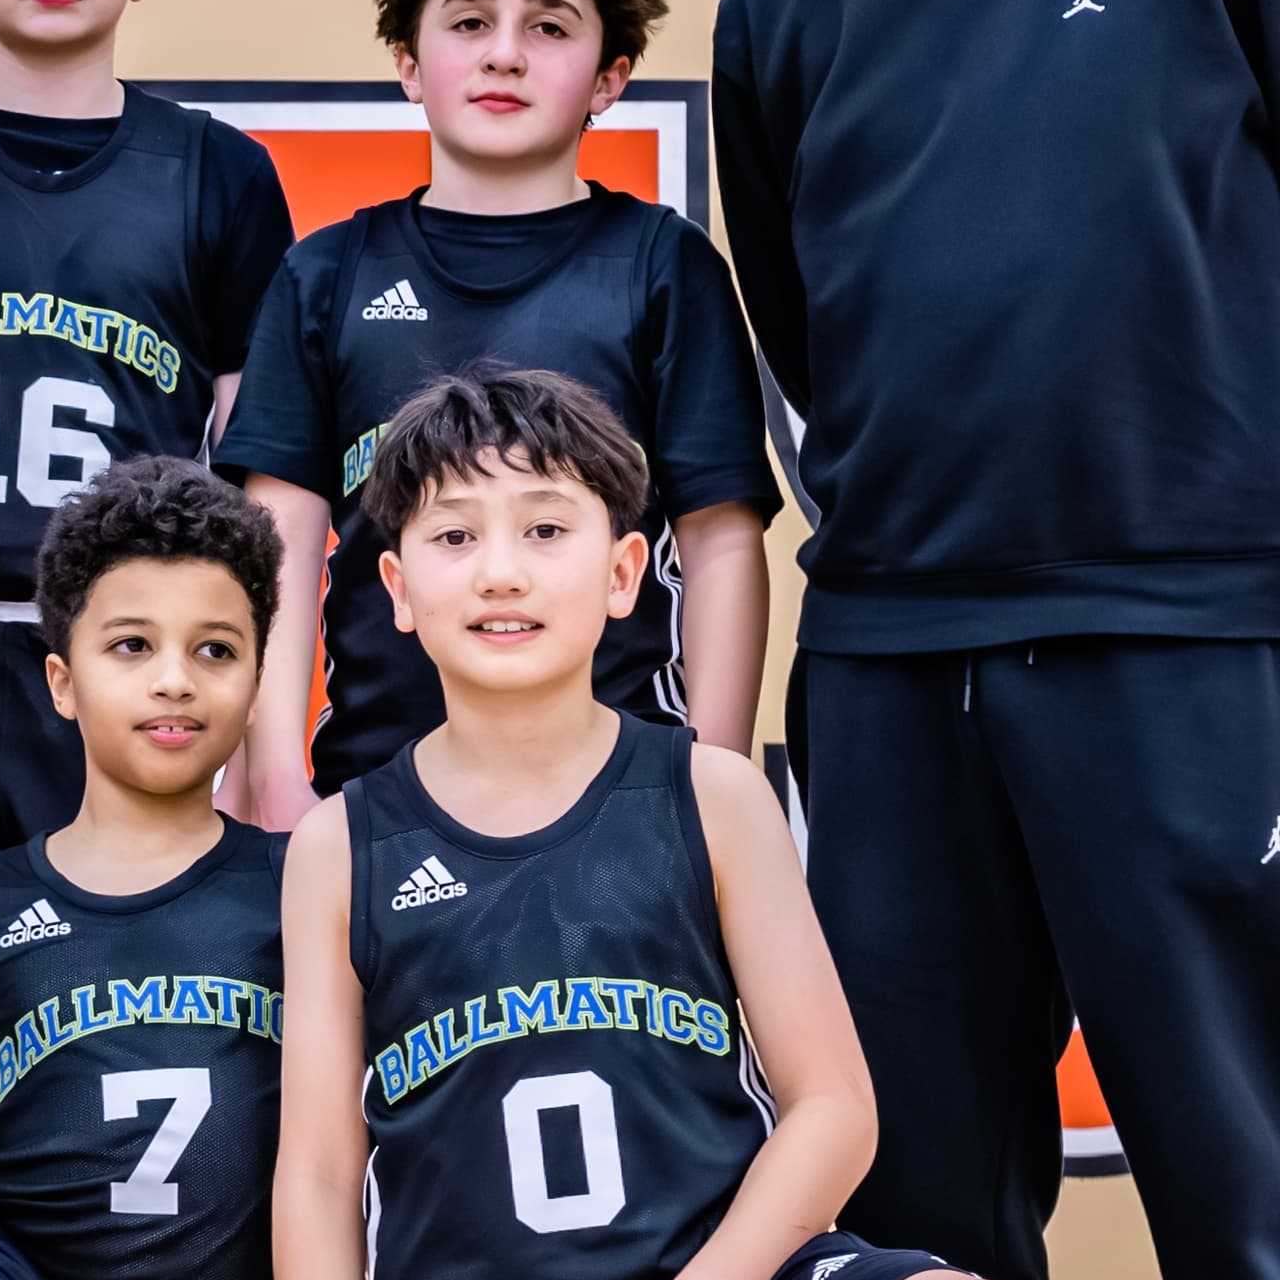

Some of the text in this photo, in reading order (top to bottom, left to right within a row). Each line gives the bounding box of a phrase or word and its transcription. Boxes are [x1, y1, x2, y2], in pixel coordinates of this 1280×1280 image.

[361, 302, 428, 322] adidas
[0, 919, 72, 948] adidas
[391, 880, 468, 911] adidas
[378, 977, 731, 1106] BALLMATICS
[101, 1067, 212, 1215] 7
[501, 1070, 626, 1234] 0
